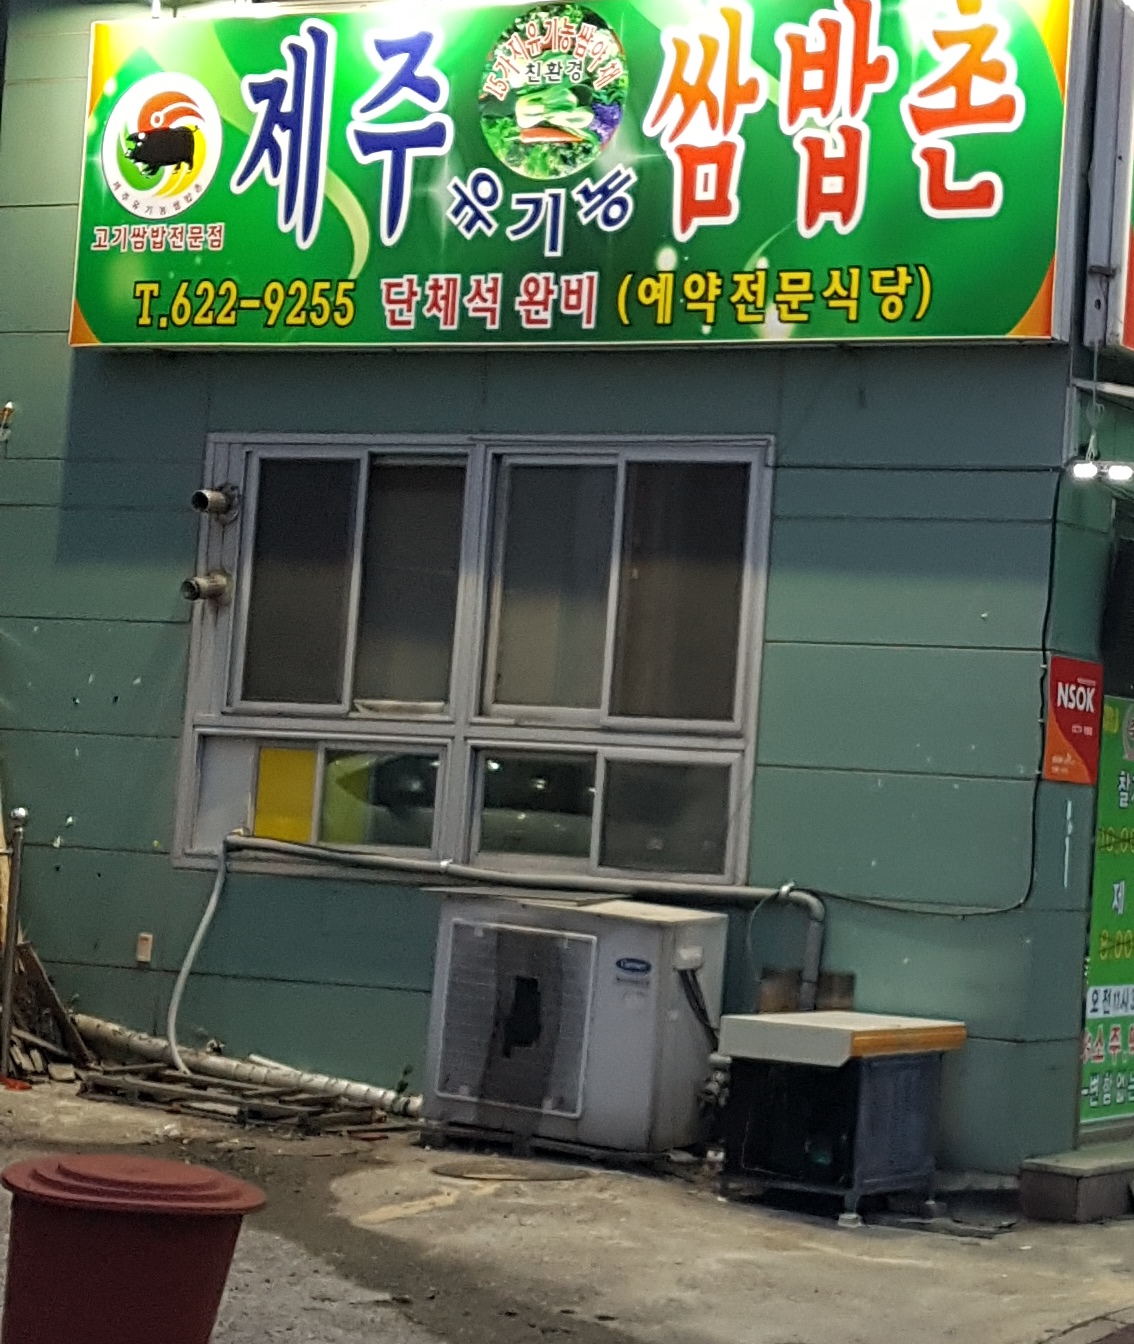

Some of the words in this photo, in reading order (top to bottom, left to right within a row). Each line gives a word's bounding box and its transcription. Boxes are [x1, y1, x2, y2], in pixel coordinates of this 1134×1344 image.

[525, 60, 583, 83] 친환경
[233, 20, 451, 250] 제주
[447, 164, 637, 256] 유기농
[91, 222, 225, 252] 고기쌈밥전문점
[133, 277, 356, 331] T.622-9255
[381, 274, 502, 330] 단체석
[516, 271, 598, 328] 완비
[617, 264, 933, 327] (예약전문식당)
[1057, 681, 1096, 713] NSOK
